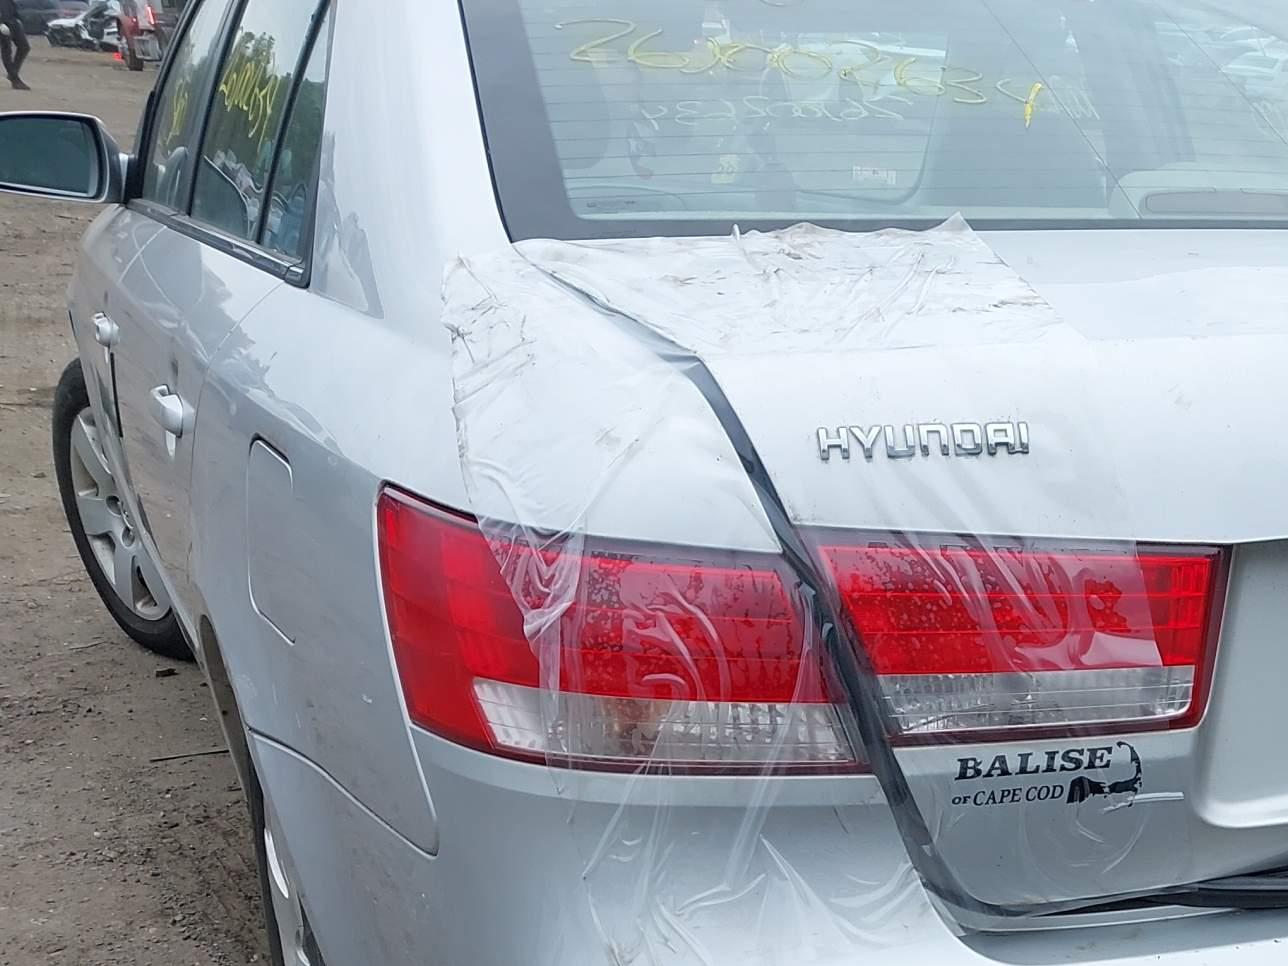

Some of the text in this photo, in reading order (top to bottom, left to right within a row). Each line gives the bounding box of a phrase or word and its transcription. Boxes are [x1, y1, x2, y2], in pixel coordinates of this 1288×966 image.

[816, 420, 1031, 461] HYUNDAI
[953, 745, 1114, 782] BALISE
[973, 787, 1023, 807] CAPE
[1025, 784, 1064, 803] COD
